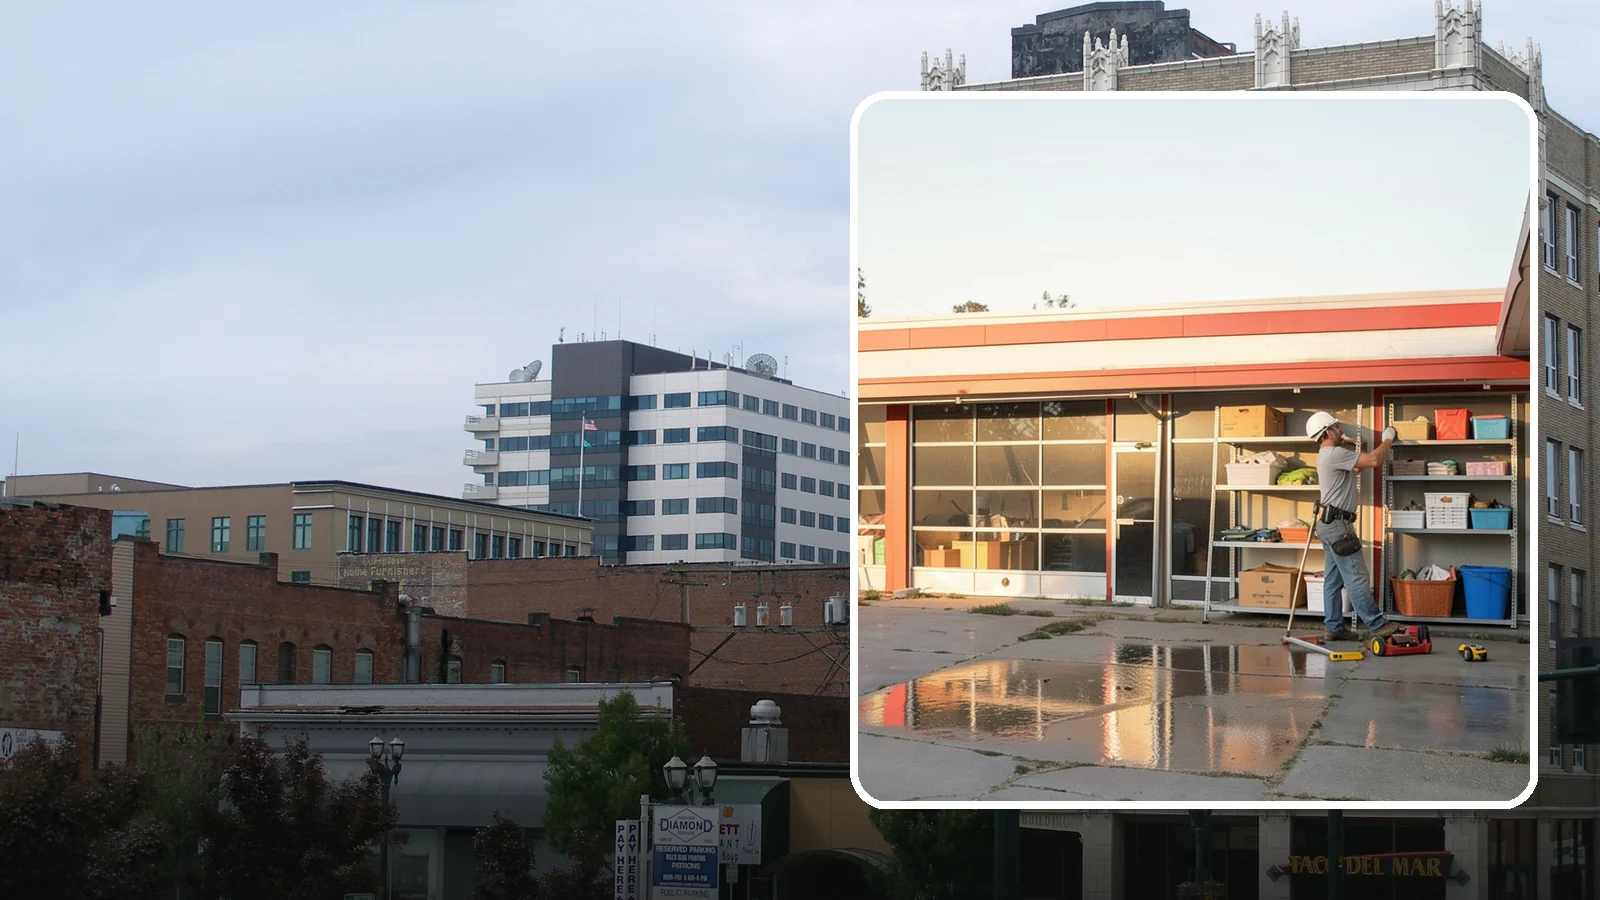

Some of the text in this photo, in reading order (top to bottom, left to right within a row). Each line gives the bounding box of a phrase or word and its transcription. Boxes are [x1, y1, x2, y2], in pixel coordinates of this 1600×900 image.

[370, 566, 427, 576] Furnishers
[655, 845, 716, 854] RESERVED PARKING
[616, 825, 625, 893] PAY HERE
[627, 825, 637, 893] PAY HERE
[671, 862, 701, 870] PATRONS
[1345, 857, 1385, 876] DEL
[1391, 857, 1443, 877] MAR
[660, 888, 710, 899] PUBLIC PARKING
